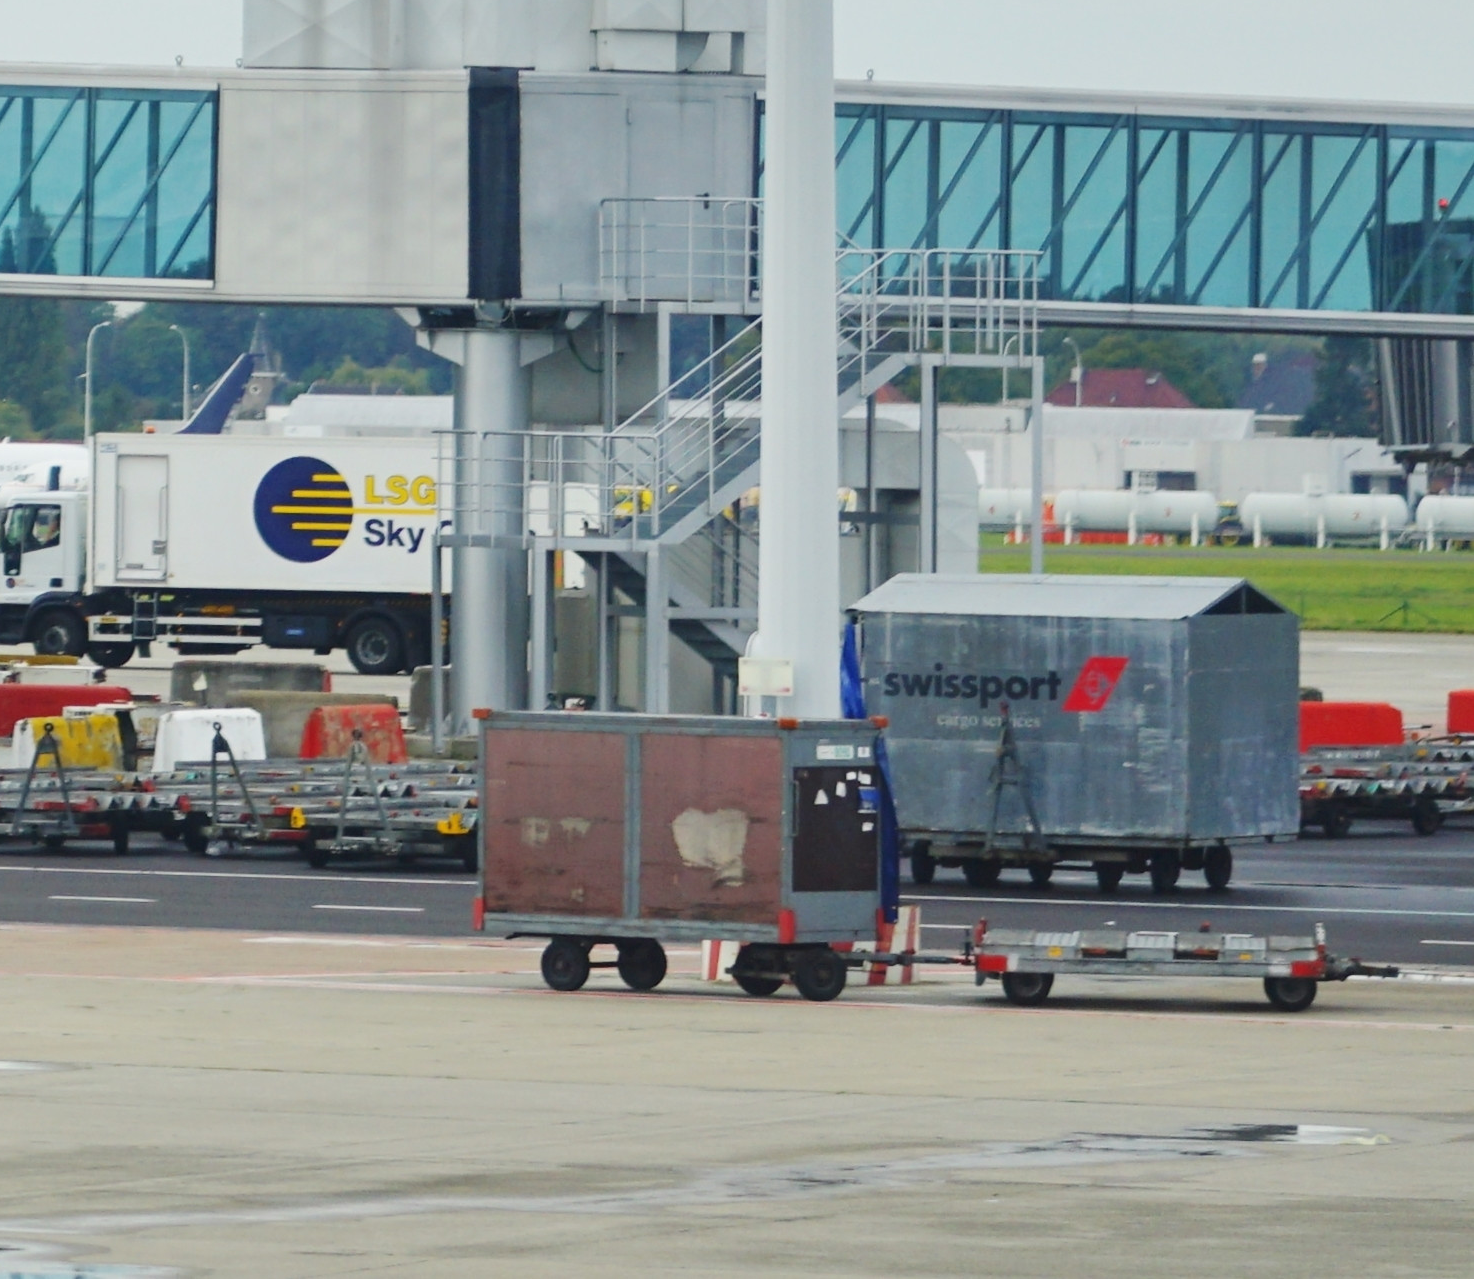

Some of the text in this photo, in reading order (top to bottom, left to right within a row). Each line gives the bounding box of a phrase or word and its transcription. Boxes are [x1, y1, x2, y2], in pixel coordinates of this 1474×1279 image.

[364, 475, 437, 505] LSG
[364, 519, 425, 553] Sky
[884, 663, 1061, 708] swissport
[937, 714, 1041, 729] cargo serices
